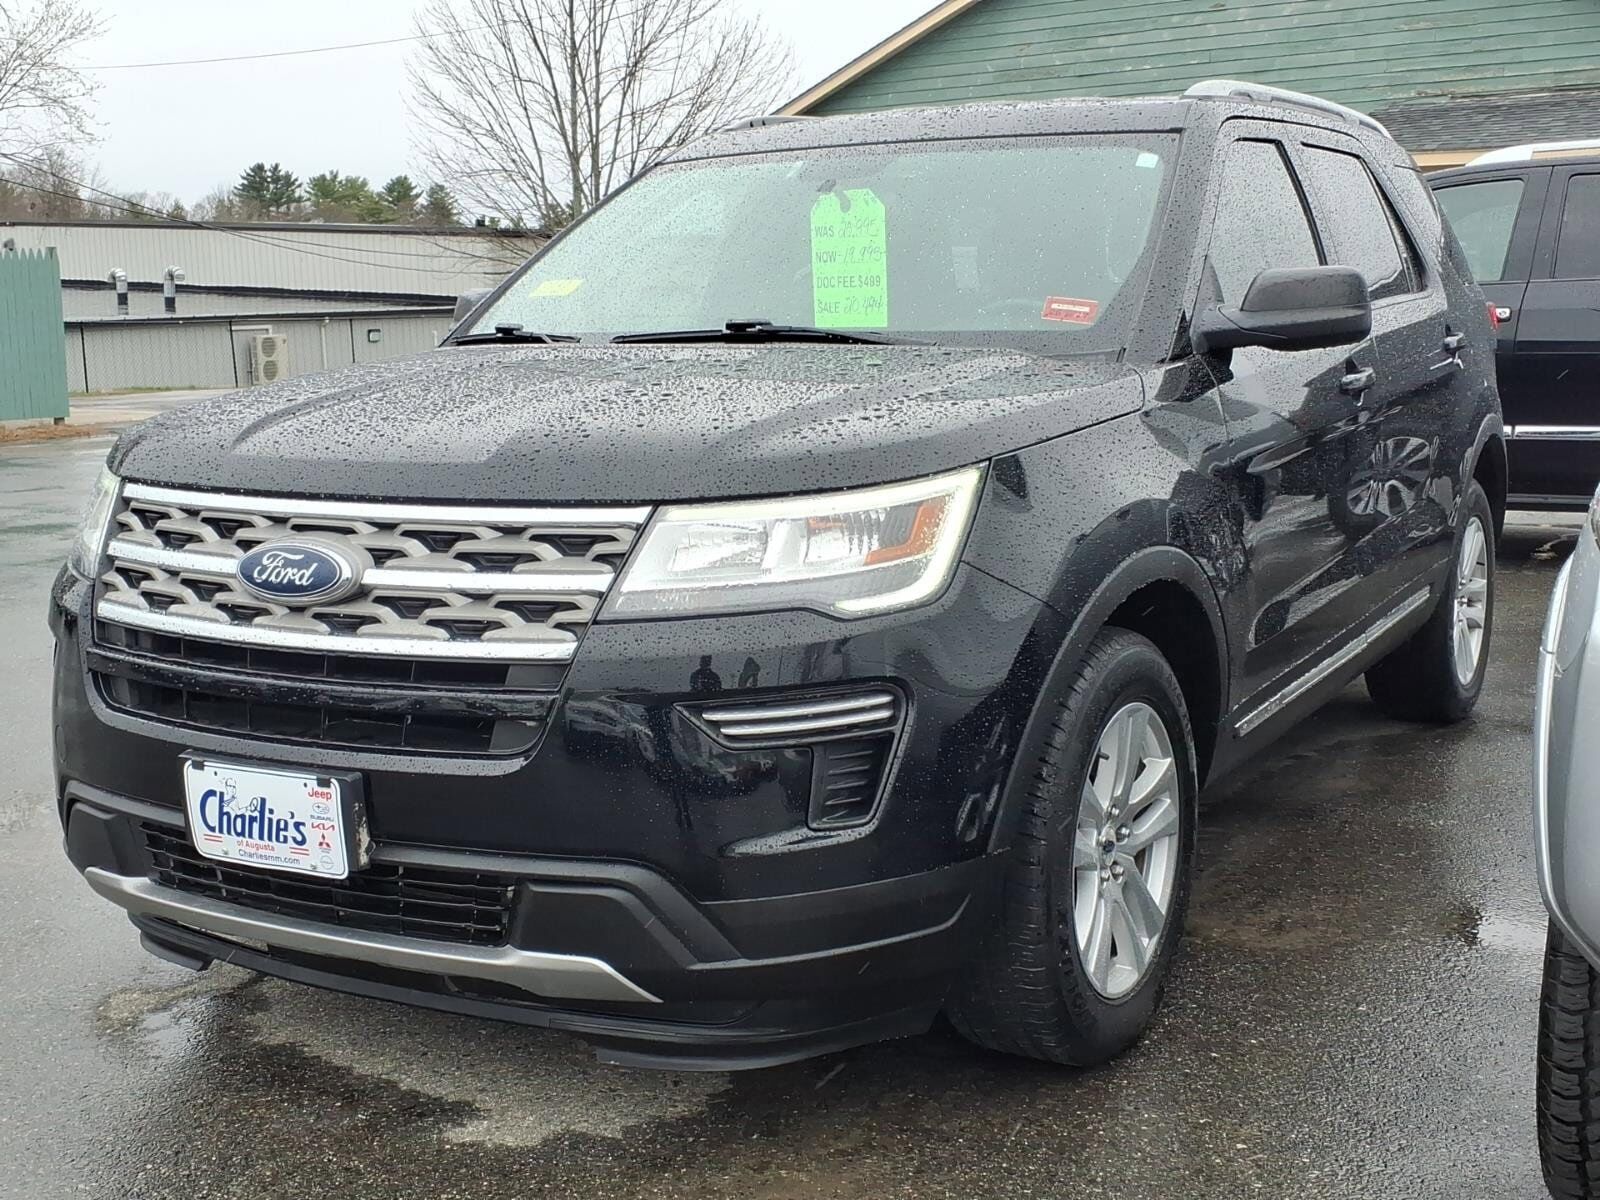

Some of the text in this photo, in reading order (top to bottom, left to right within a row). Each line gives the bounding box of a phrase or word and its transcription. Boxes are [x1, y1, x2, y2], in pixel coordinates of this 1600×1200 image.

[814, 225, 835, 238] WAS
[815, 251, 837, 264] NOW
[816, 276, 835, 288] DOC
[838, 276, 856, 288] FEE
[816, 299, 841, 314] SALE
[253, 550, 318, 586] Ford
[307, 787, 332, 802] Jeep
[199, 788, 307, 846] Charlie's
[245, 840, 276, 852] Augusta
[238, 849, 301, 865] Charliesmm.com
